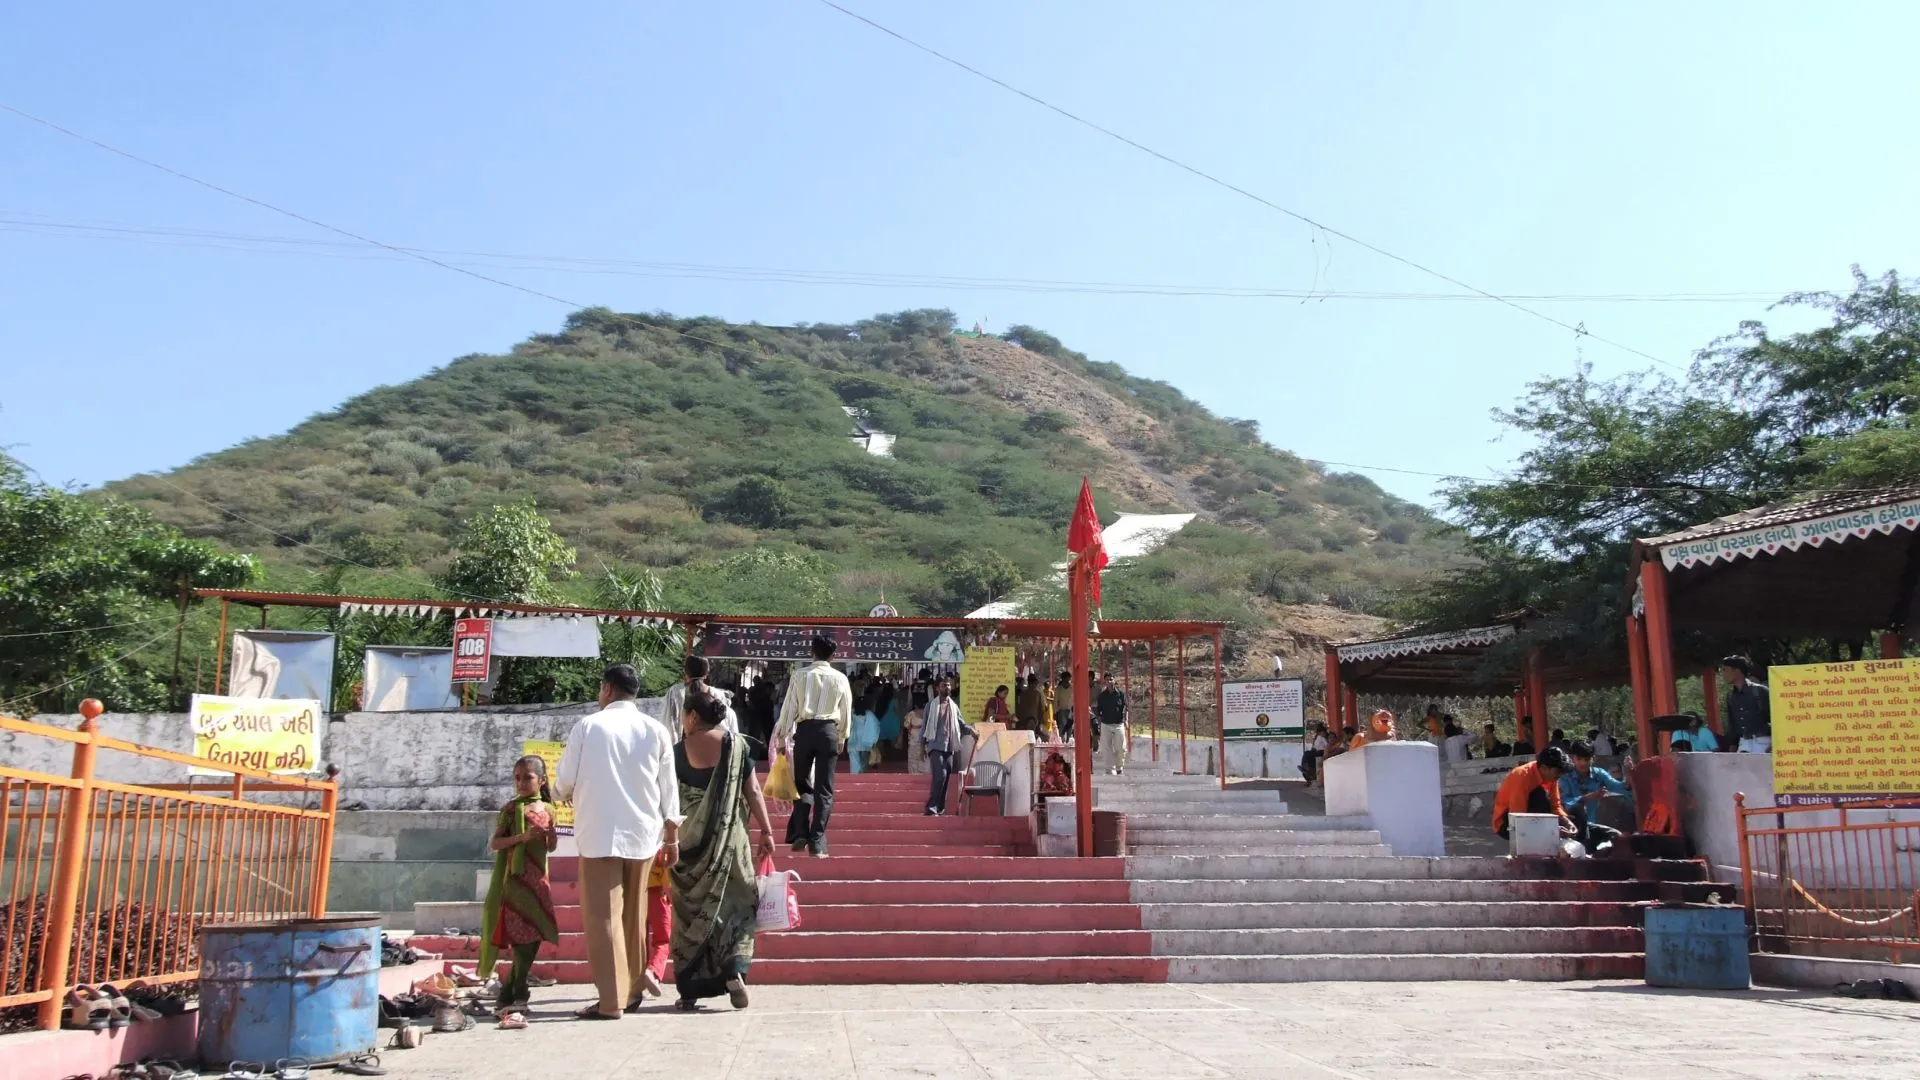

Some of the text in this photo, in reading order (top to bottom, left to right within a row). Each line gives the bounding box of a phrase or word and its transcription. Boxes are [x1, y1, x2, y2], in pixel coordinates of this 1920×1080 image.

[1720, 534, 1764, 550] વરસાદ
[1878, 503, 1920, 525] હરીયા
[459, 638, 485, 656] 108
[1825, 664, 1855, 673] ખાસ
[1863, 661, 1905, 674] સુચના
